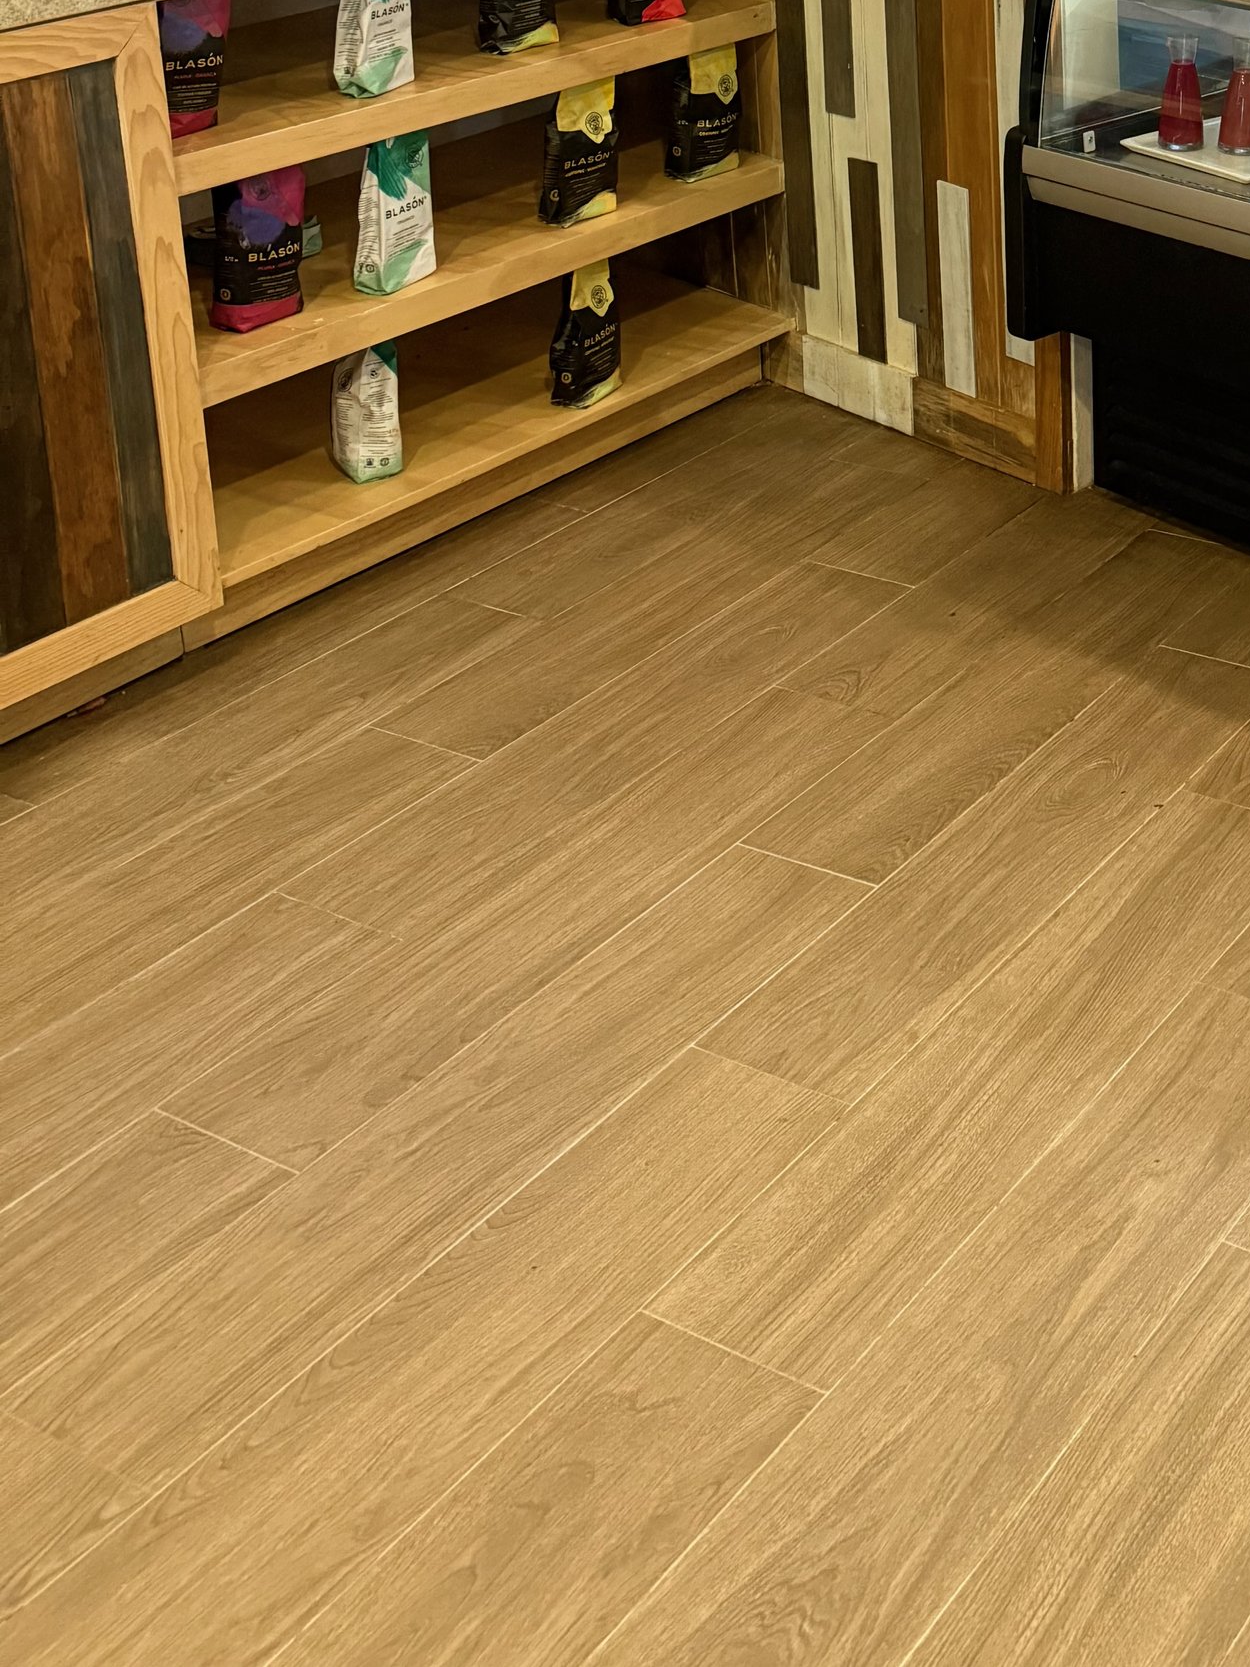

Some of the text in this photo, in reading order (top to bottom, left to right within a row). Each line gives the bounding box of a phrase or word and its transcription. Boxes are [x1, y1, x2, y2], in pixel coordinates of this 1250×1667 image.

[371, 1, 405, 20] BLASÓN
[165, 52, 223, 71] BLASÓN
[564, 150, 610, 170] BLASÓN
[385, 196, 424, 220] BLASÓN
[248, 240, 300, 263] BLASÓN
